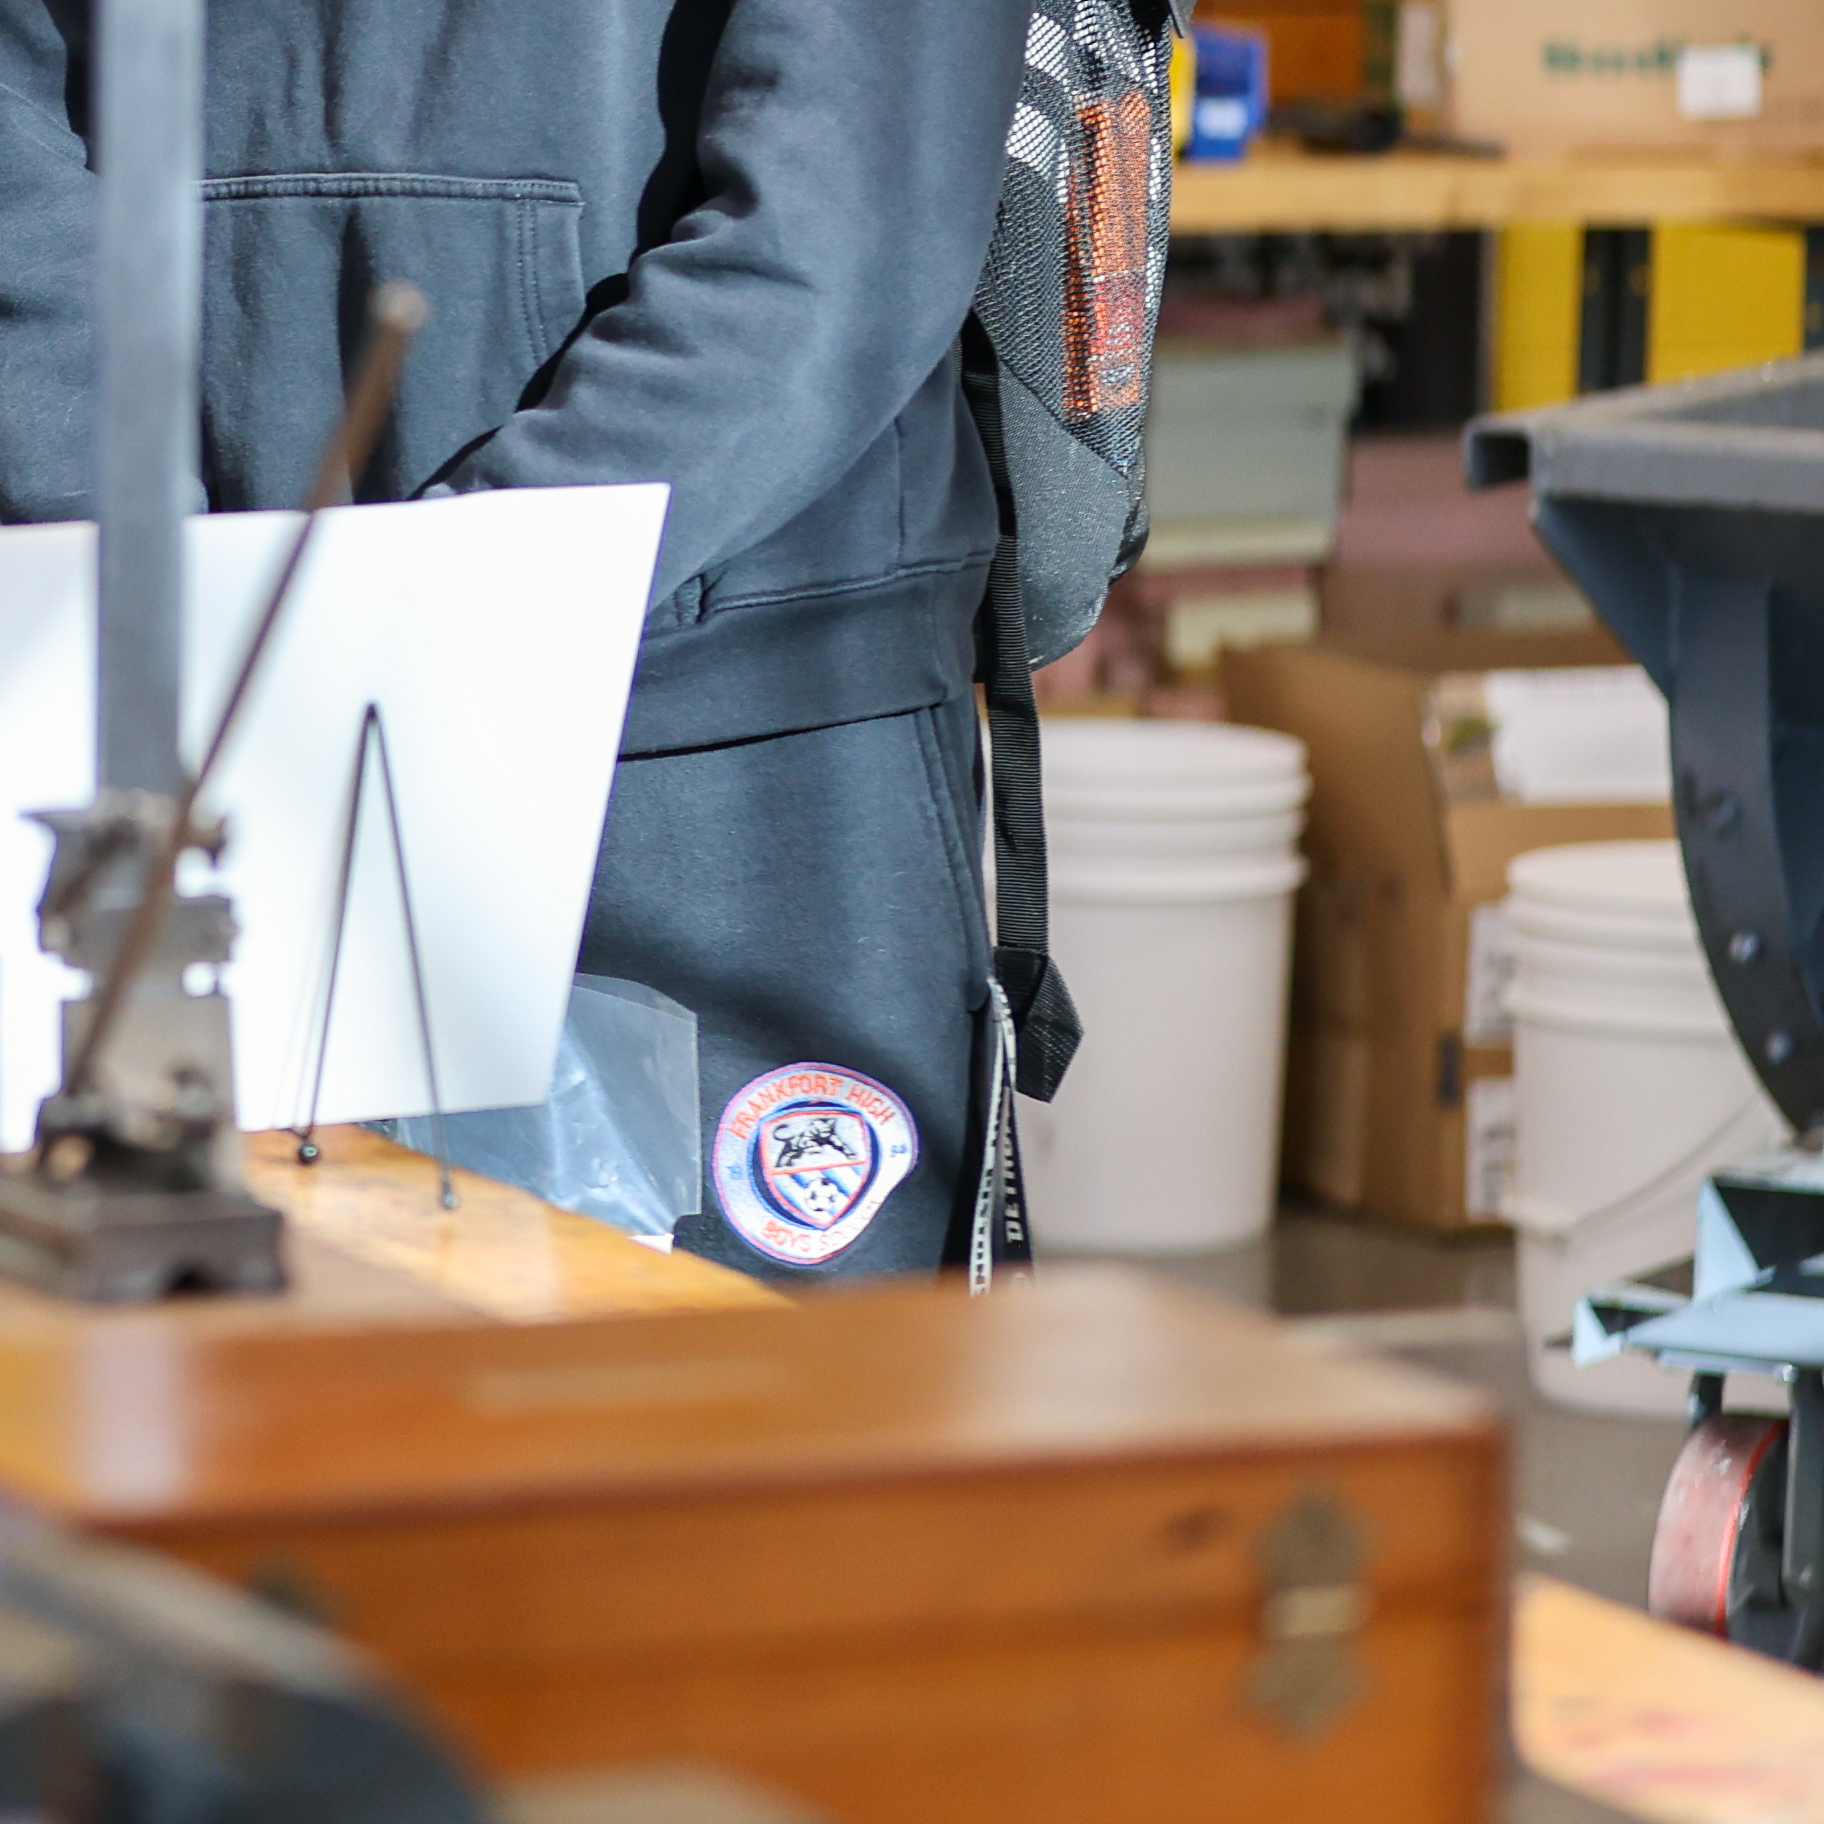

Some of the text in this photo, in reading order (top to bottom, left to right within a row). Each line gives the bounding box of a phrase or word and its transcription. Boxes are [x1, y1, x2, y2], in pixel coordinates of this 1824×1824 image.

[729, 1073, 896, 1140] FRANKFORT HIGH
[760, 1219, 811, 1253] BOYS
